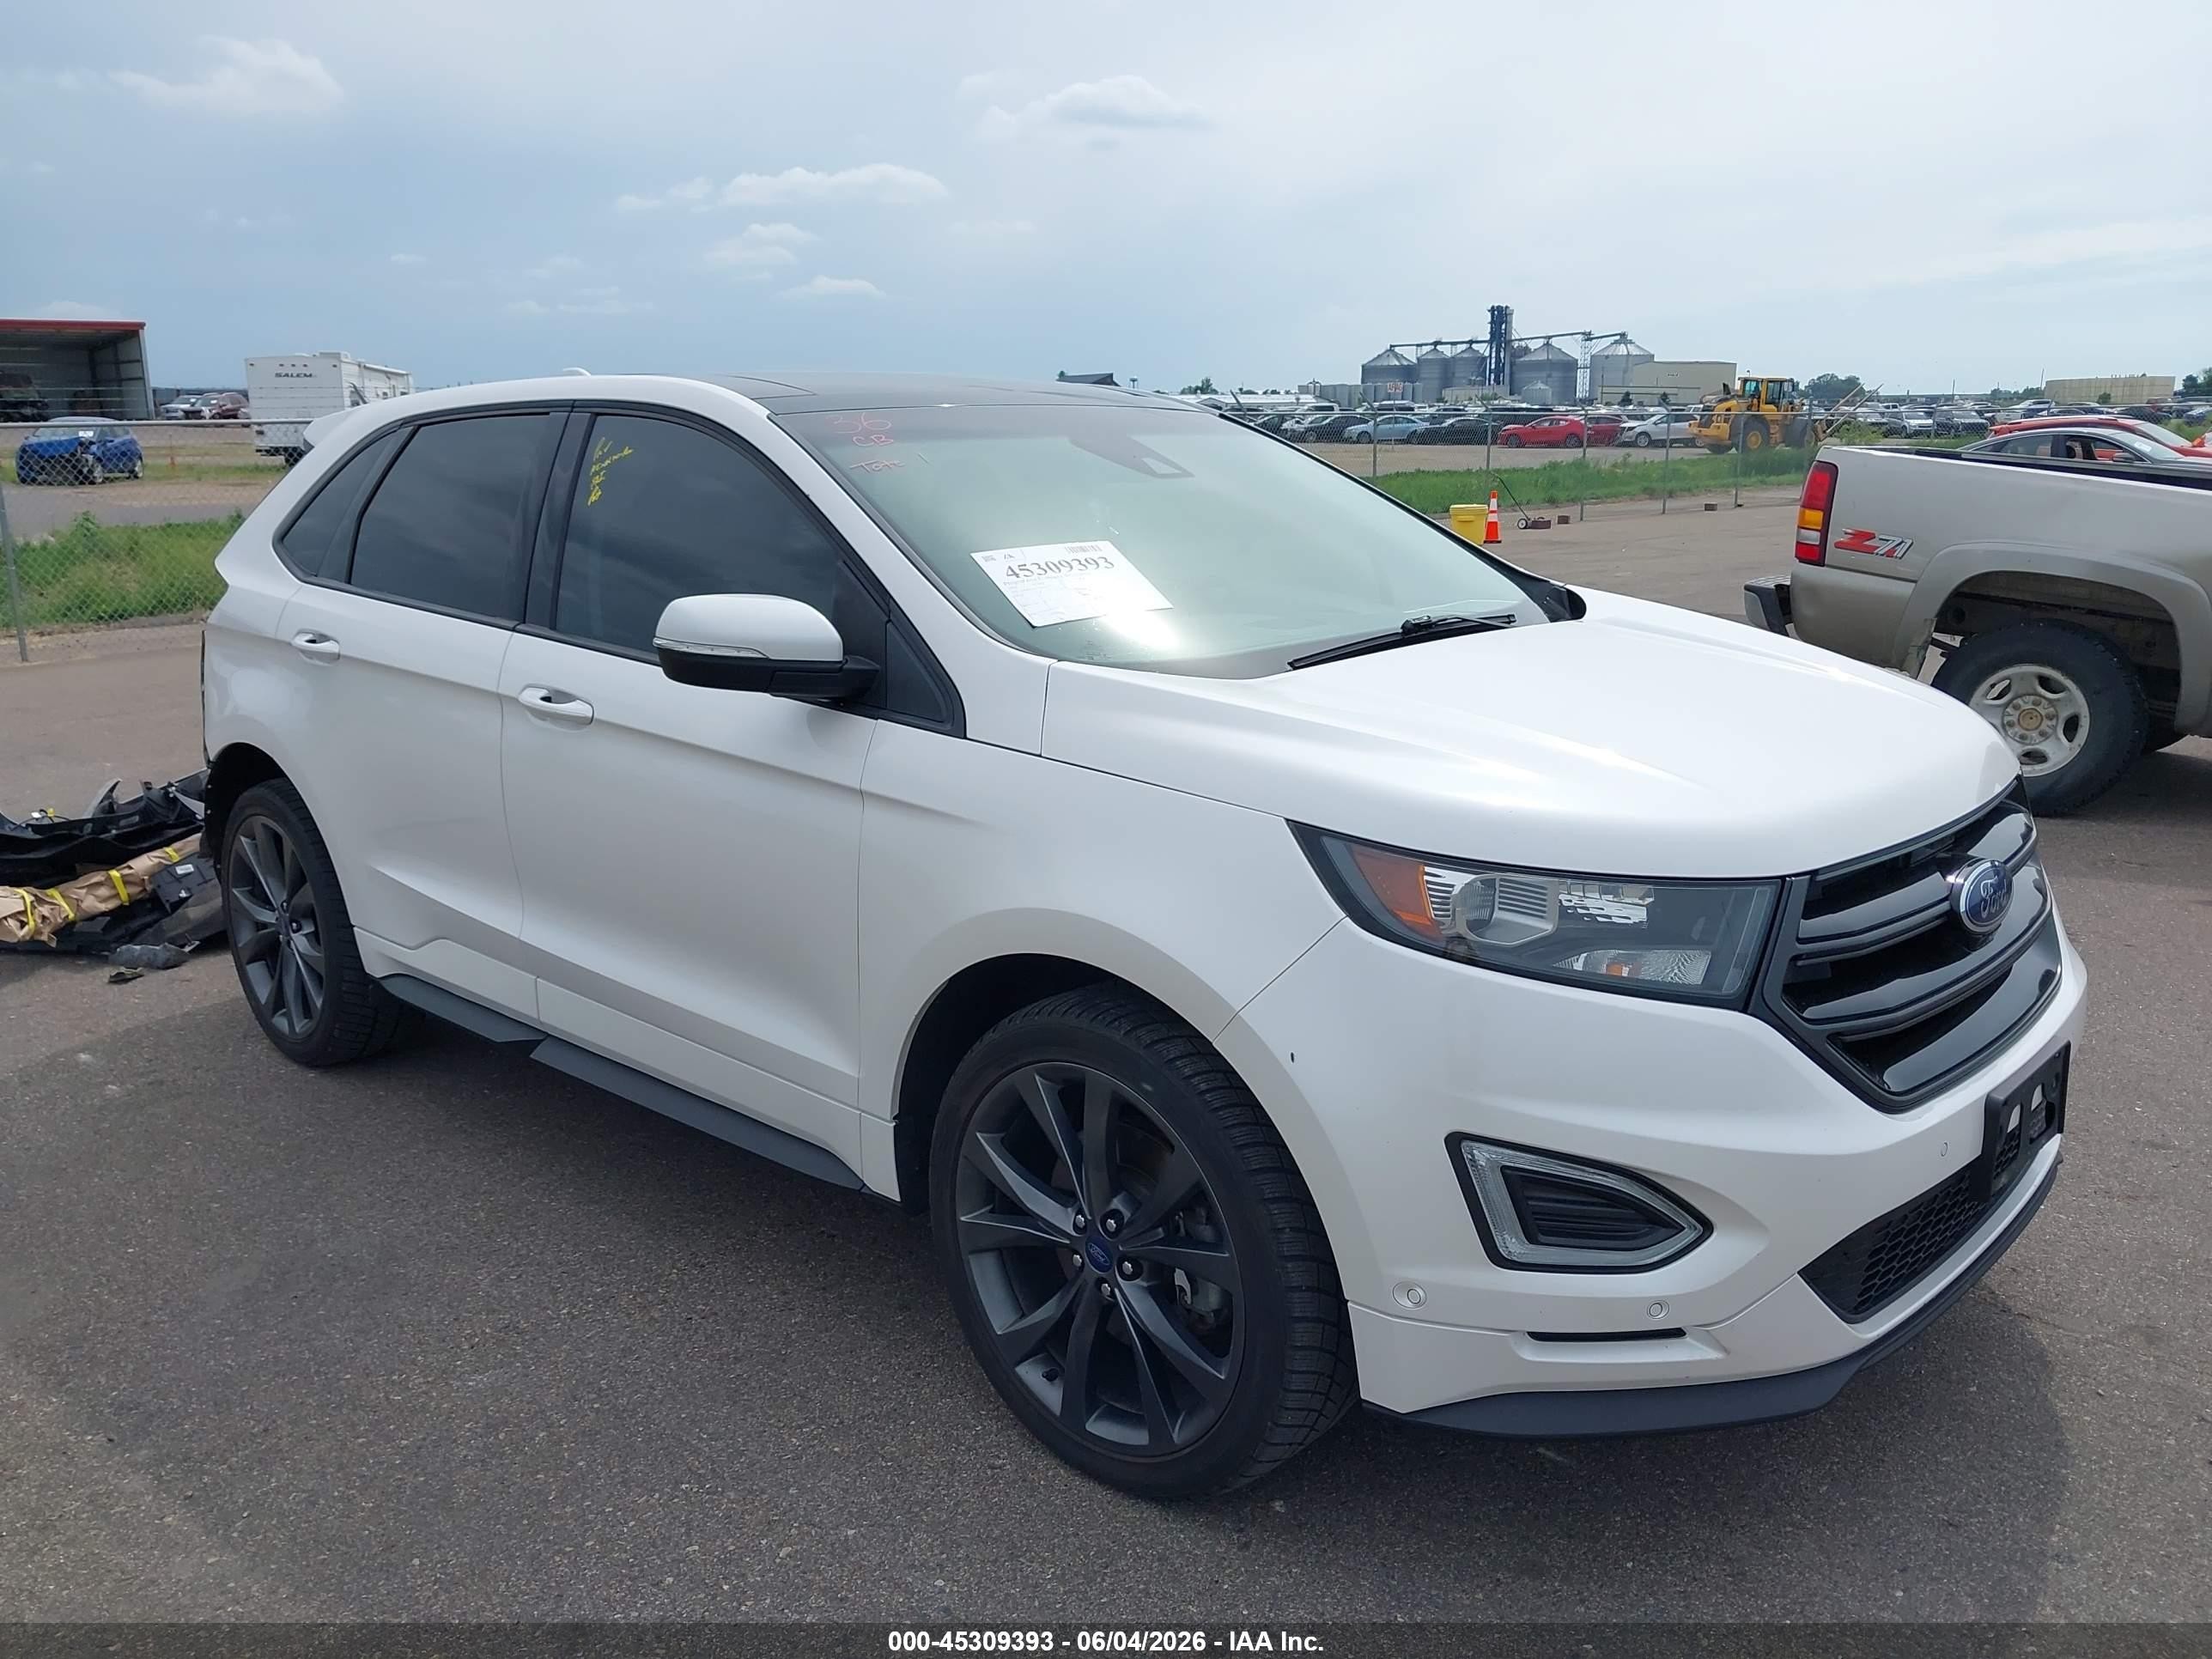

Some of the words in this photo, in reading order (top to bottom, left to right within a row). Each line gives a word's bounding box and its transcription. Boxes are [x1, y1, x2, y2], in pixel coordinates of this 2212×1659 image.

[1833, 527, 1914, 560] Z71
[1006, 556, 1115, 579] 45309393
[1980, 875, 2008, 919] Ford
